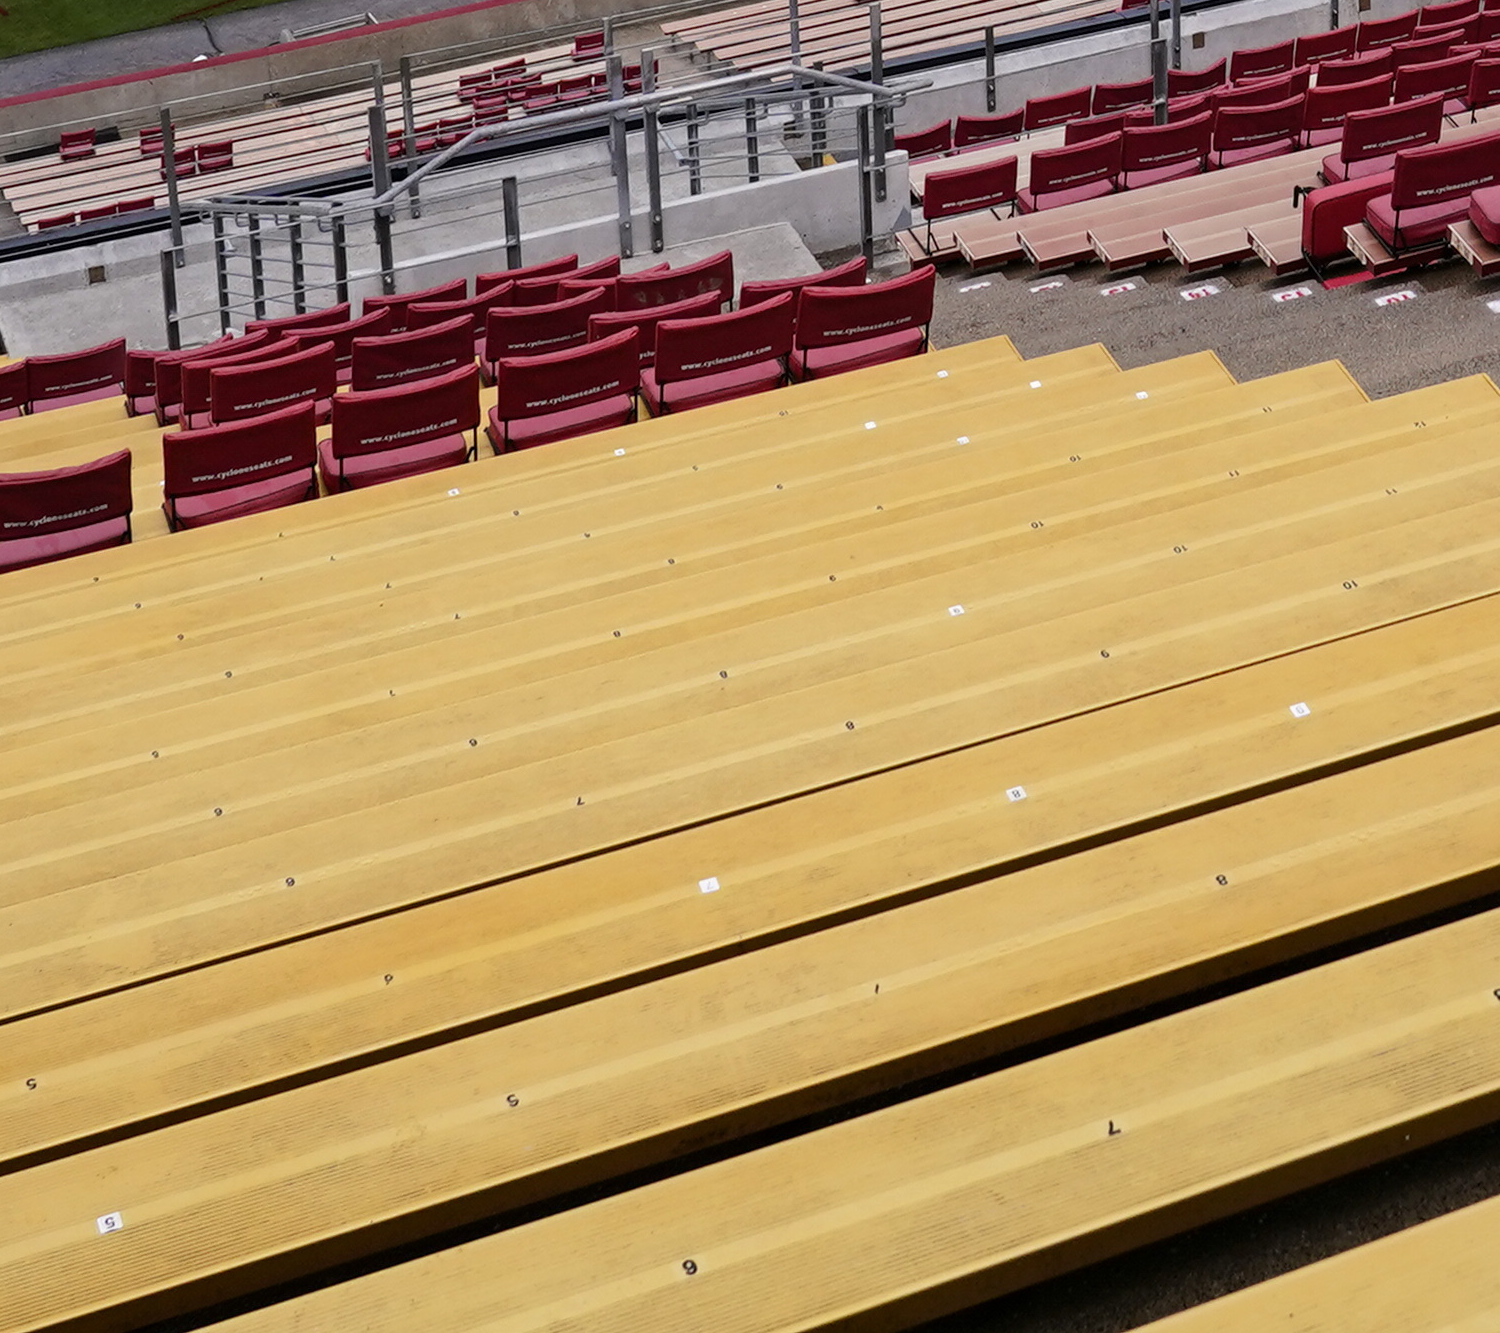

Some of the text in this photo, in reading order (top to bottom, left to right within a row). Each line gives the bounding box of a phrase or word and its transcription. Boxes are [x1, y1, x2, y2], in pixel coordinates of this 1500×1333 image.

[822, 315, 912, 338] www.cycloneseats.com
[680, 345, 772, 371] www.cycloneseats.com
[525, 379, 620, 409] www.cycloneseats.com
[360, 417, 459, 446] www.cycloneseats.com
[191, 453, 294, 484] www.cycloneseats.com
[3, 502, 109, 530] www.cycloneseats.com
